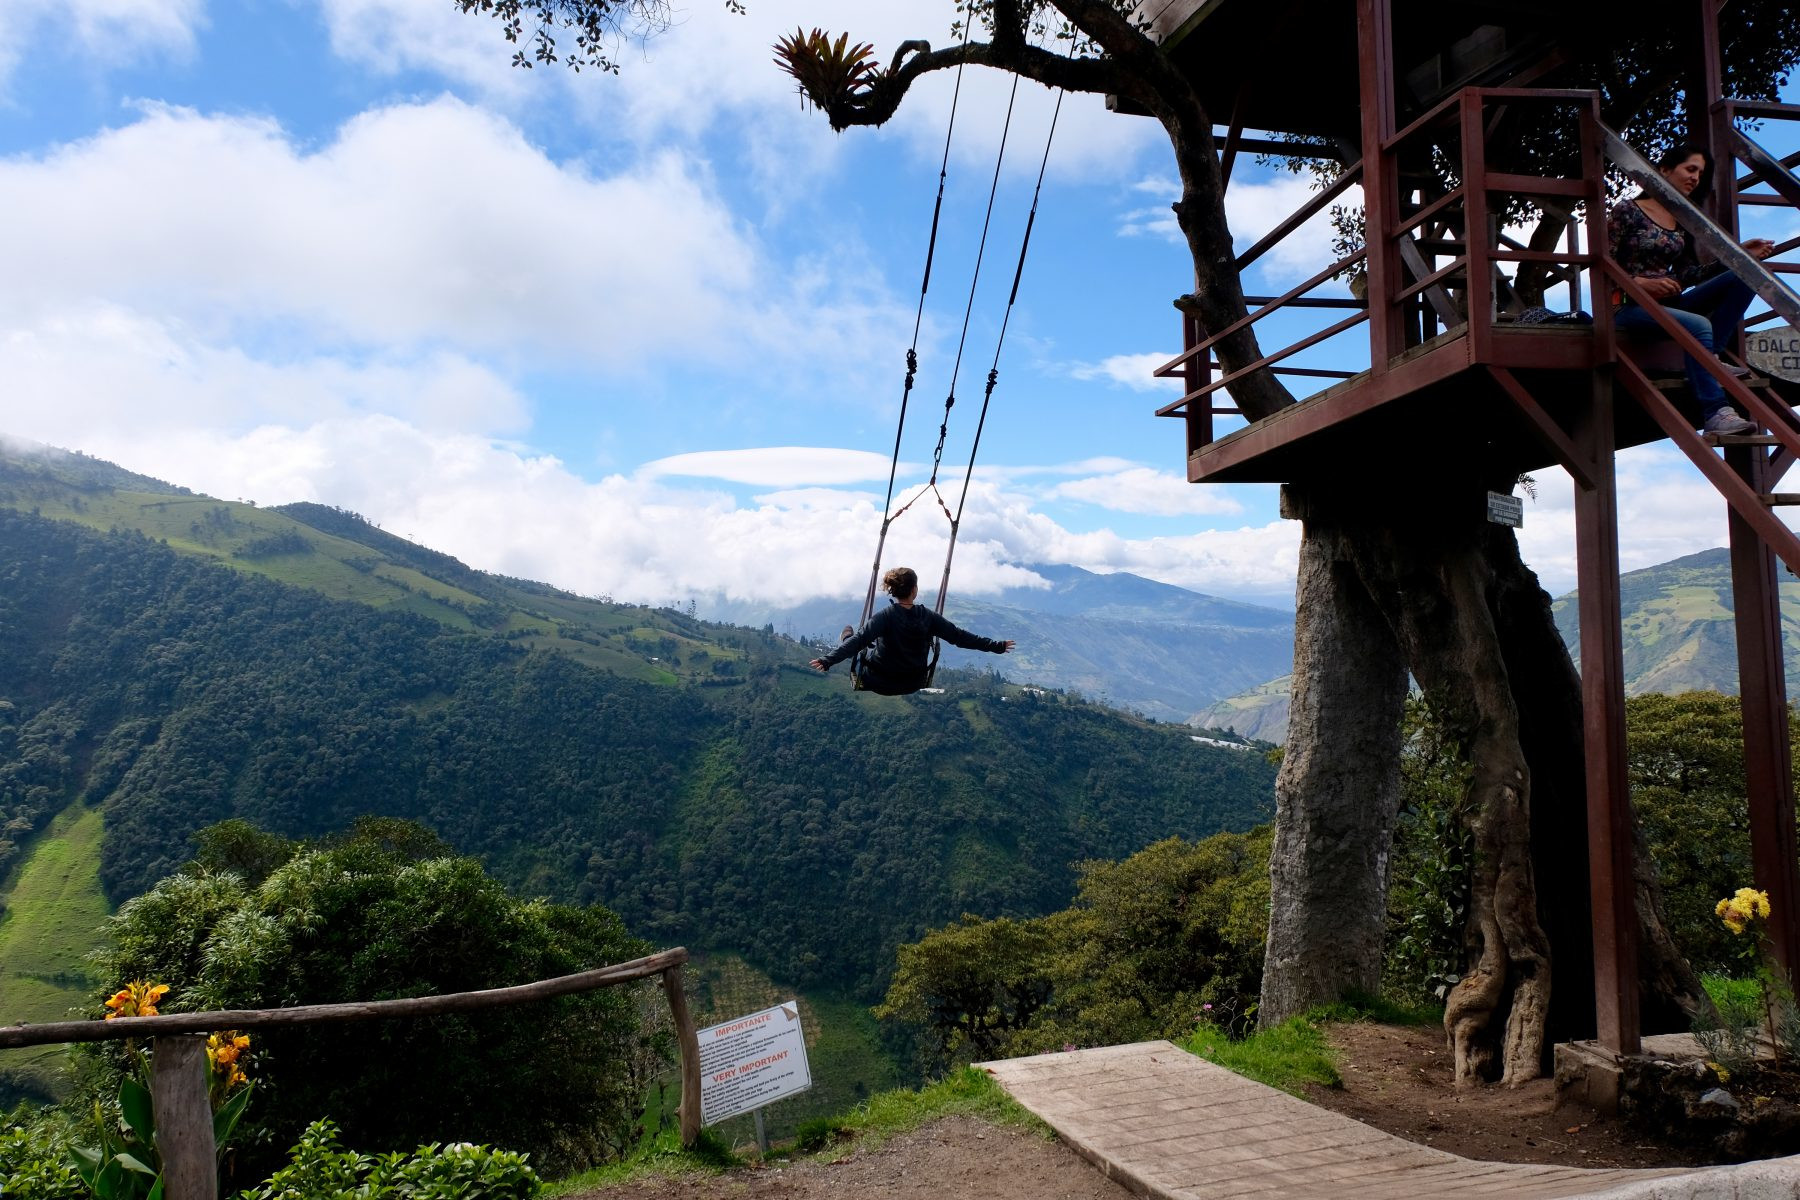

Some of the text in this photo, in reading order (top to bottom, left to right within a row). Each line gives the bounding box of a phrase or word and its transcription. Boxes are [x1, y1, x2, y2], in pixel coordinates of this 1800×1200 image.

[715, 1014, 772, 1037] IMPORTANTE
[712, 1068, 737, 1083] VERY
[739, 1050, 789, 1074] IMPORTANT
